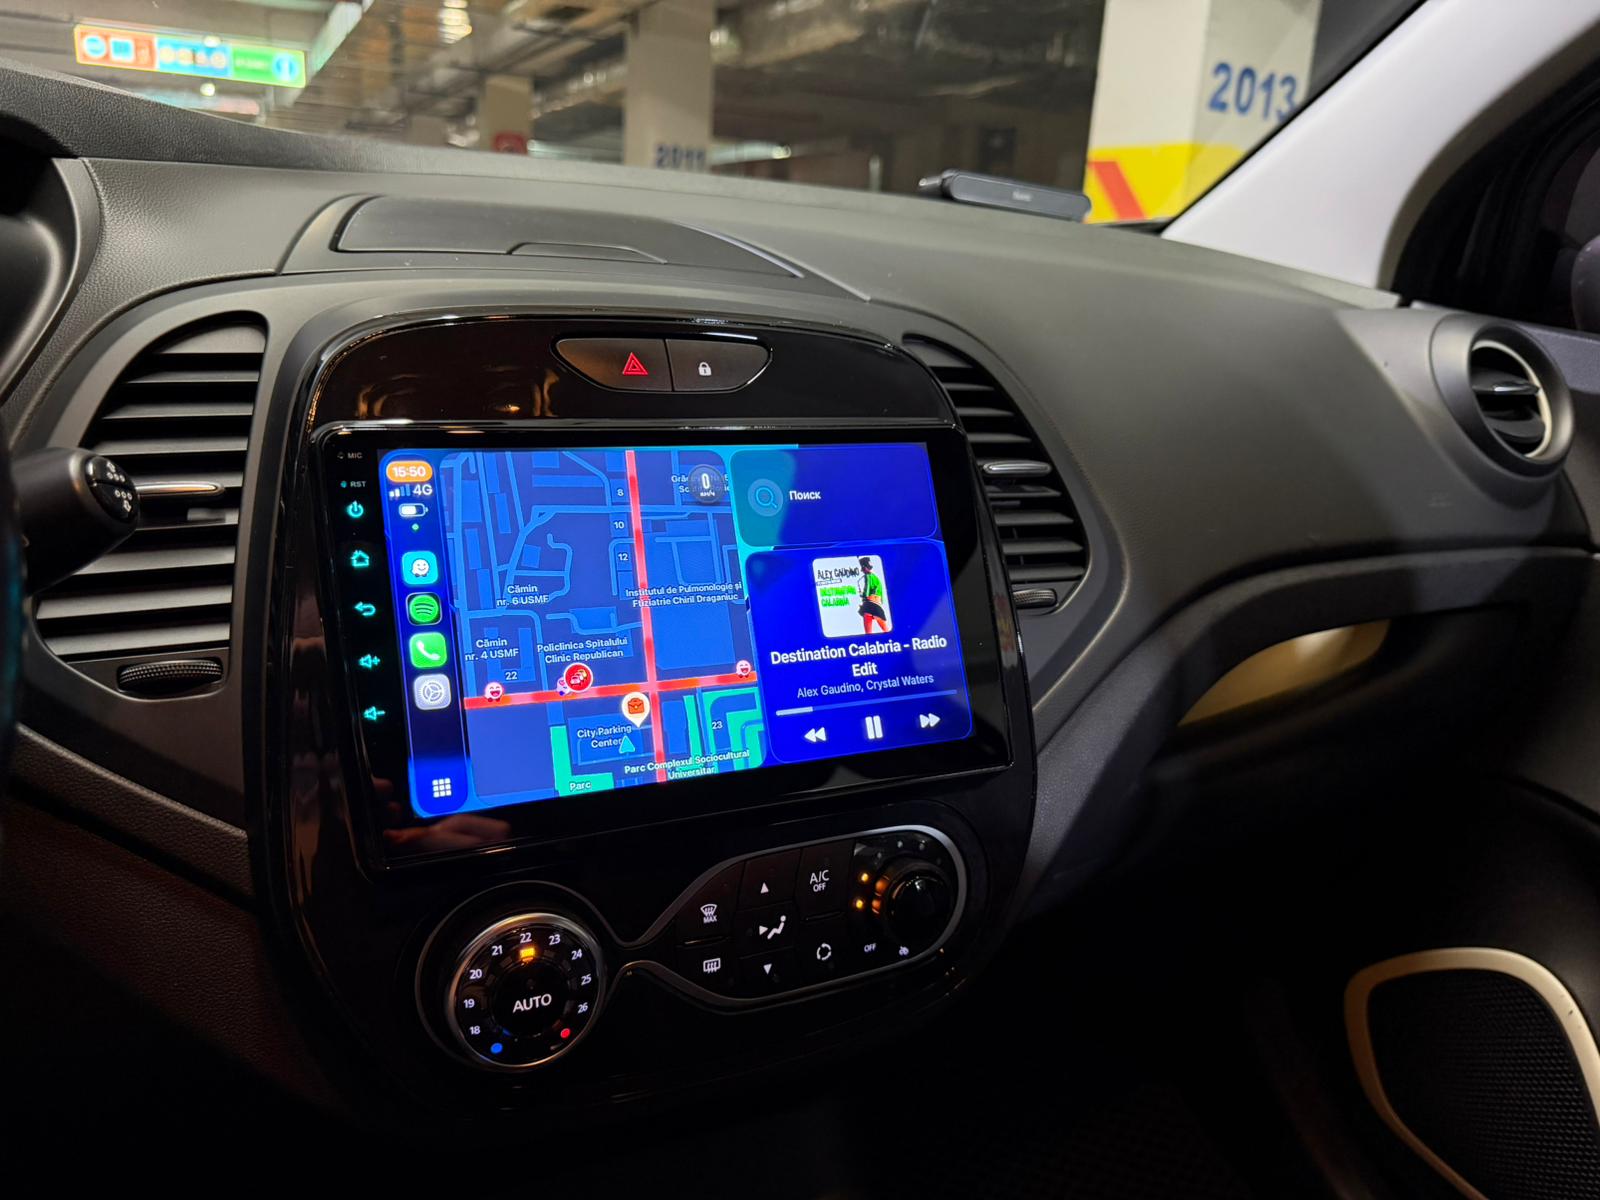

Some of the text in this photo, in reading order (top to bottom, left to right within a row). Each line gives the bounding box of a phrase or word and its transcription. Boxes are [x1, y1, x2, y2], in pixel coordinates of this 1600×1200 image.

[1208, 61, 1298, 124] 2013
[392, 466, 427, 477] 15:50
[412, 484, 433, 495] 4G
[789, 490, 822, 501] Поиск
[614, 521, 625, 529] 10
[618, 553, 628, 561] 12
[625, 588, 664, 597] Institutul
[679, 582, 733, 593] Pulmonologie
[512, 597, 519, 605] 6
[521, 595, 549, 605] USMF
[673, 596, 695, 604] Chiril
[537, 637, 628, 653] Policlinica Spitalului
[771, 646, 846, 664] Destination
[848, 641, 901, 657] Calabria
[911, 635, 947, 651] Radio
[465, 648, 519, 661] nr. 4 USMF
[545, 650, 624, 663] Clinic Republican
[852, 662, 878, 677] Edit
[505, 671, 518, 681] 22
[797, 674, 934, 698] Alex Gaudino, Crystal Waters
[598, 725, 632, 736] Parking
[712, 720, 723, 730] 23
[624, 749, 750, 774] Parc Complexul Sociocultural
[668, 766, 716, 780] Universitar
[570, 781, 591, 791] Parc
[810, 870, 829, 884] A/C
[813, 883, 826, 892] OFF
[703, 915, 717, 923] MAX
[520, 932, 532, 943] 22
[549, 934, 561, 945] 23
[491, 945, 503, 956] 21
[864, 943, 876, 952] OFF
[571, 949, 583, 960] 24
[469, 968, 483, 980] 20
[580, 974, 592, 985] 25
[463, 998, 475, 1009] 19
[512, 993, 552, 1013] AUTO
[577, 1002, 589, 1014] 26
[469, 1026, 481, 1035] 18
